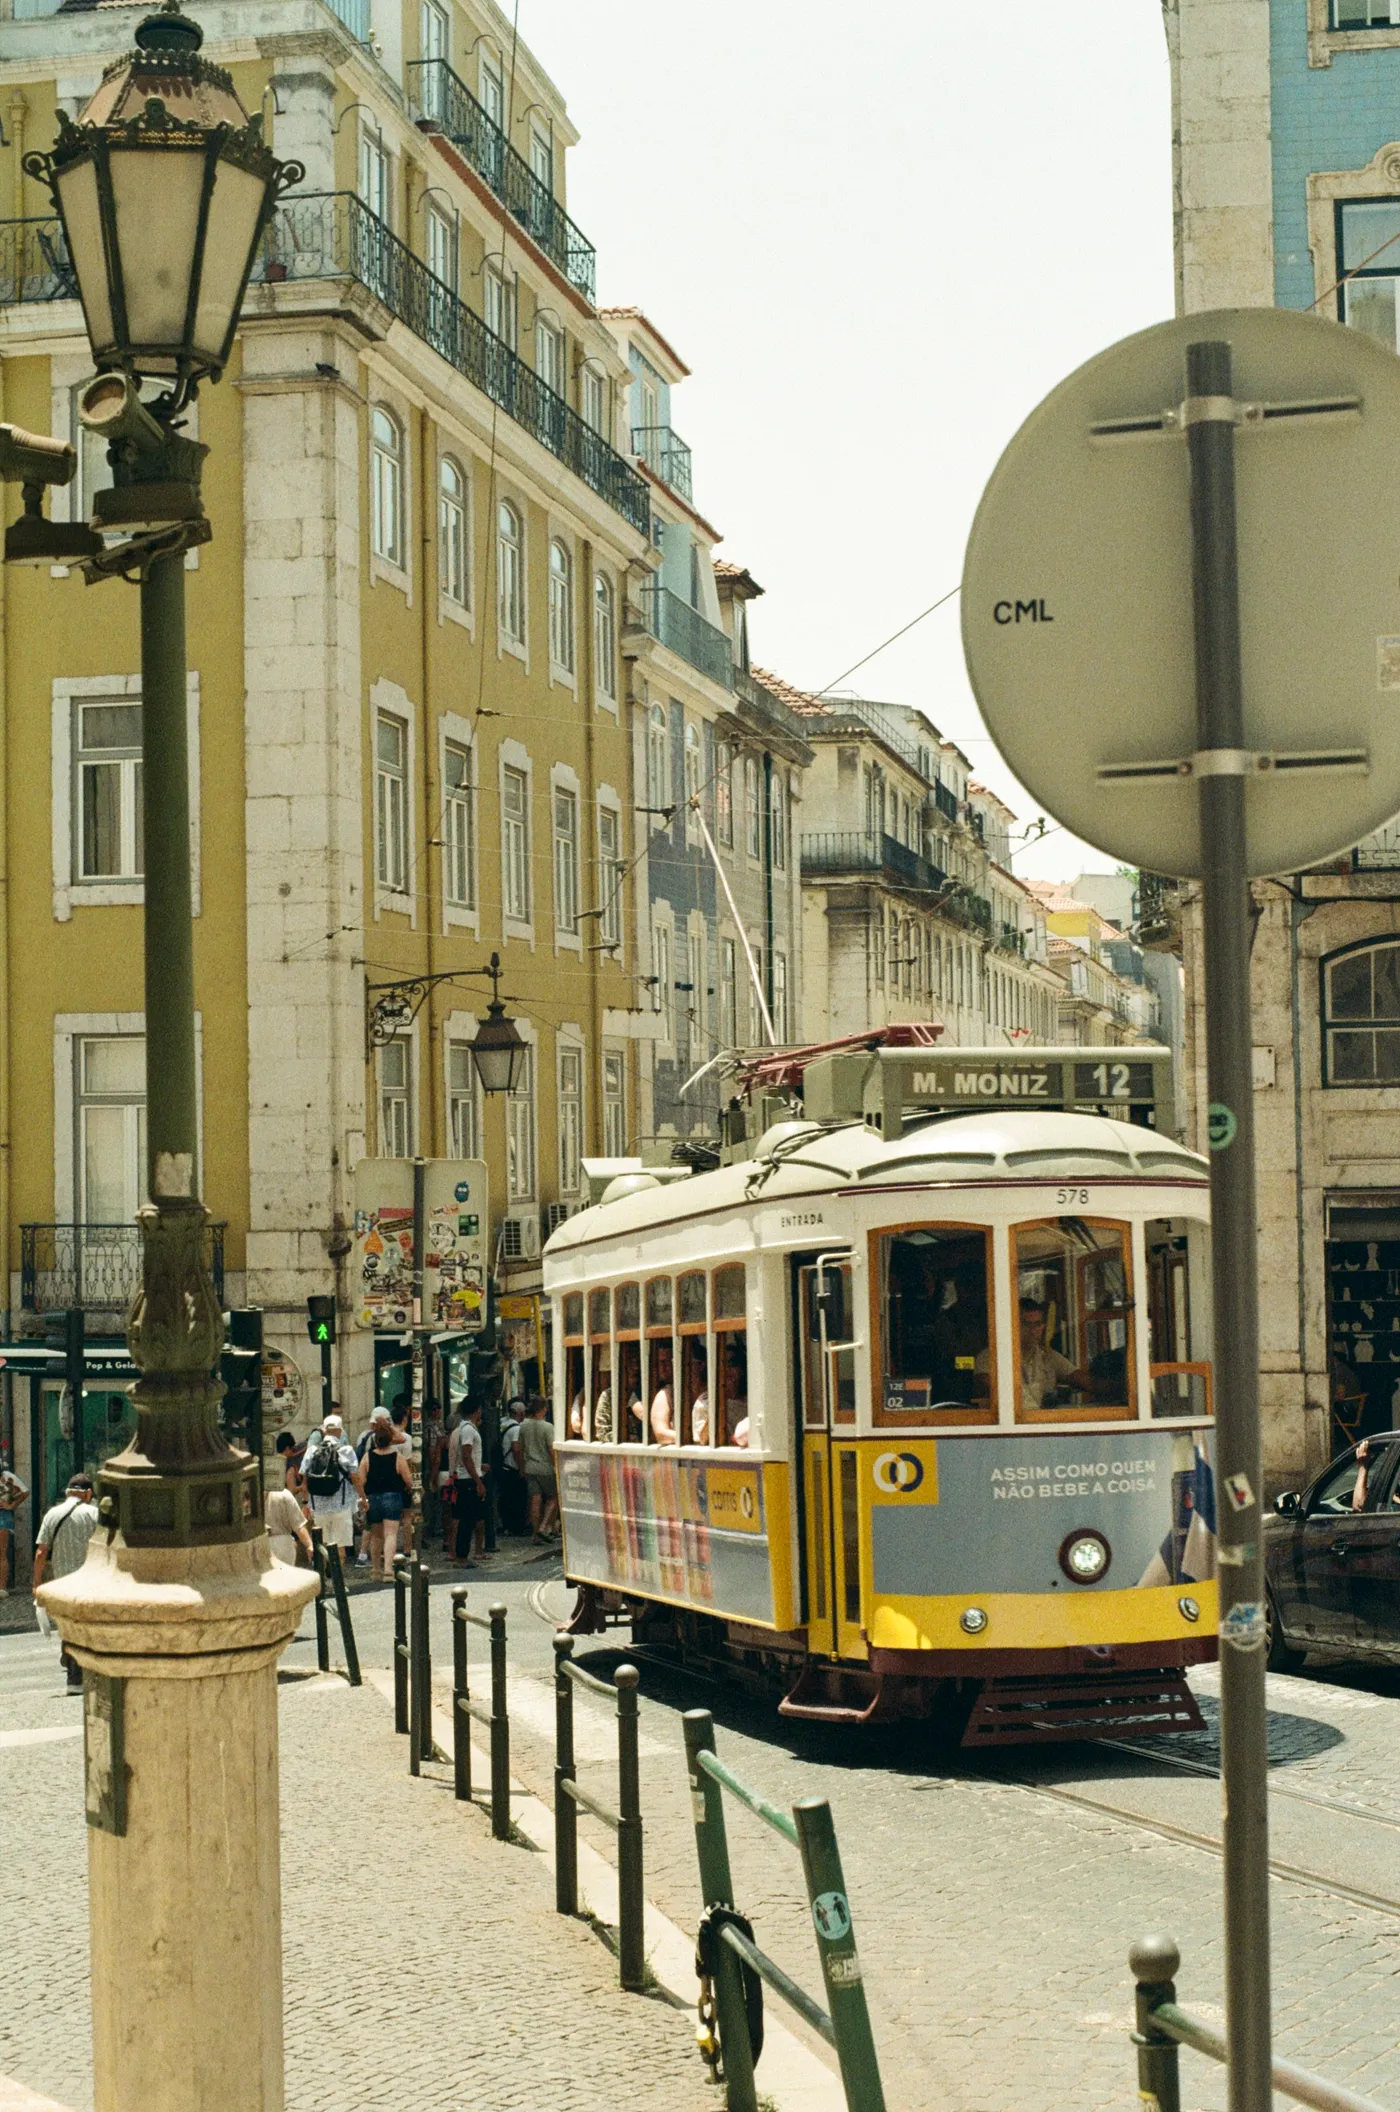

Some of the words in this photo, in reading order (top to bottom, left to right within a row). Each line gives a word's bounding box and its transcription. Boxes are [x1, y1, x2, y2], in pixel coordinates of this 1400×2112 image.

[993, 598, 1054, 625] CML
[913, 1072, 944, 1094] M.
[954, 1073, 1048, 1096] MONIZ
[1093, 1064, 1131, 1096] 12
[1057, 1189, 1089, 1204] 578
[781, 1213, 824, 1228] ENTRADA
[86, 1361, 103, 1370] Pop
[105, 1361, 112, 1369] &
[887, 1396, 904, 1408] 02
[990, 1466, 1050, 1482] ASSIM
[1054, 1463, 1108, 1479] COMO
[993, 1483, 1034, 1500] NÃO
[1039, 1482, 1089, 1498] BEBE
[1092, 1481, 1104, 1495] A
[1107, 1478, 1155, 1493] COISA
